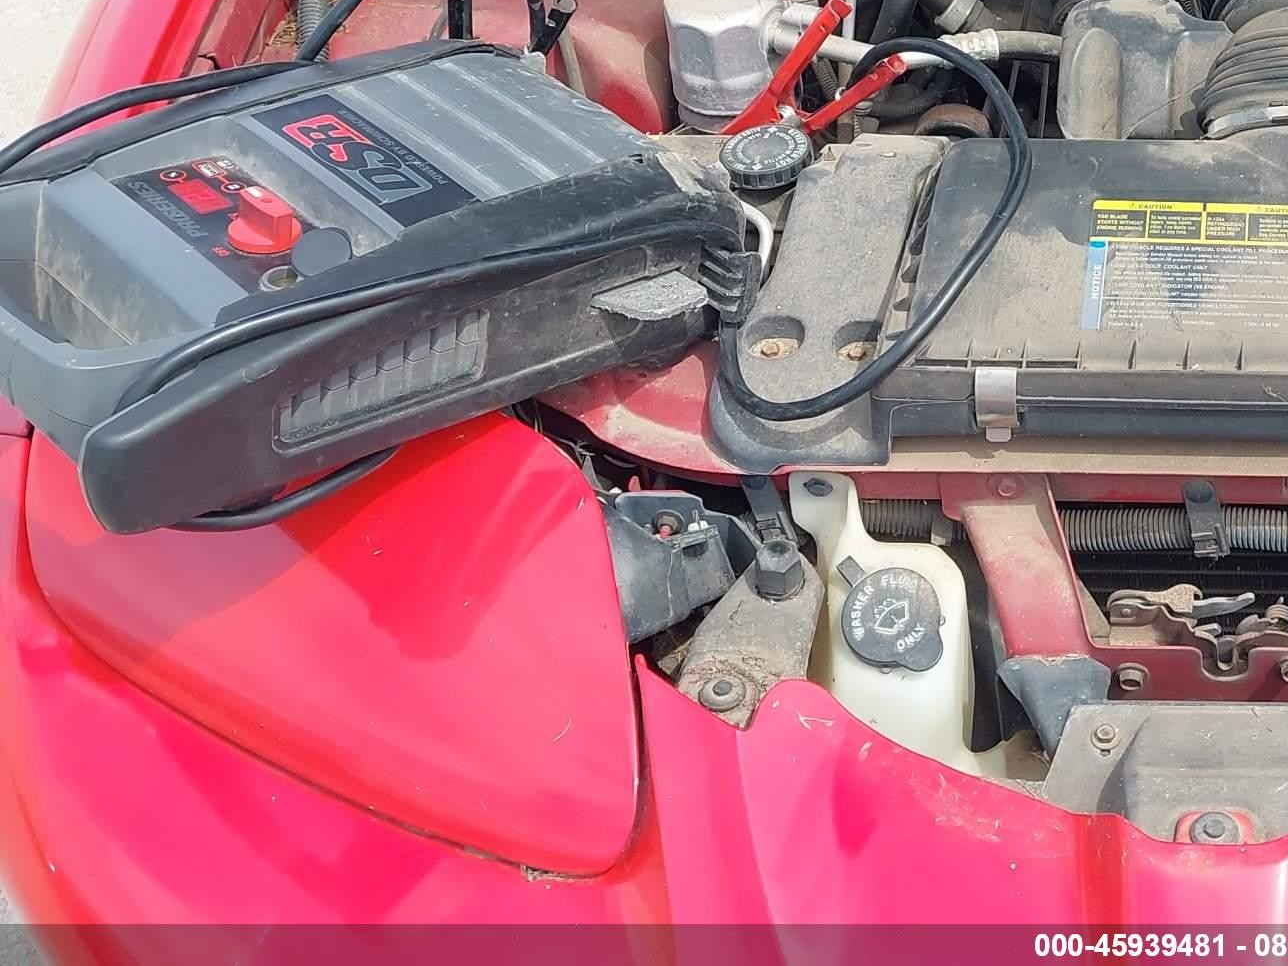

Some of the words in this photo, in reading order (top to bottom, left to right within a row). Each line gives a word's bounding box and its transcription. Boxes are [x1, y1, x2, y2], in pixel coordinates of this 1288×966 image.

[288, 119, 428, 197] DSR
[395, 147, 406, 155] BY
[775, 157, 793, 168] HOT
[405, 155, 449, 184] POWERED
[127, 181, 209, 238] PROSERIES
[1091, 264, 1102, 299] NOTICE
[851, 582, 876, 641] WASHER
[896, 623, 926, 652] ONLY
